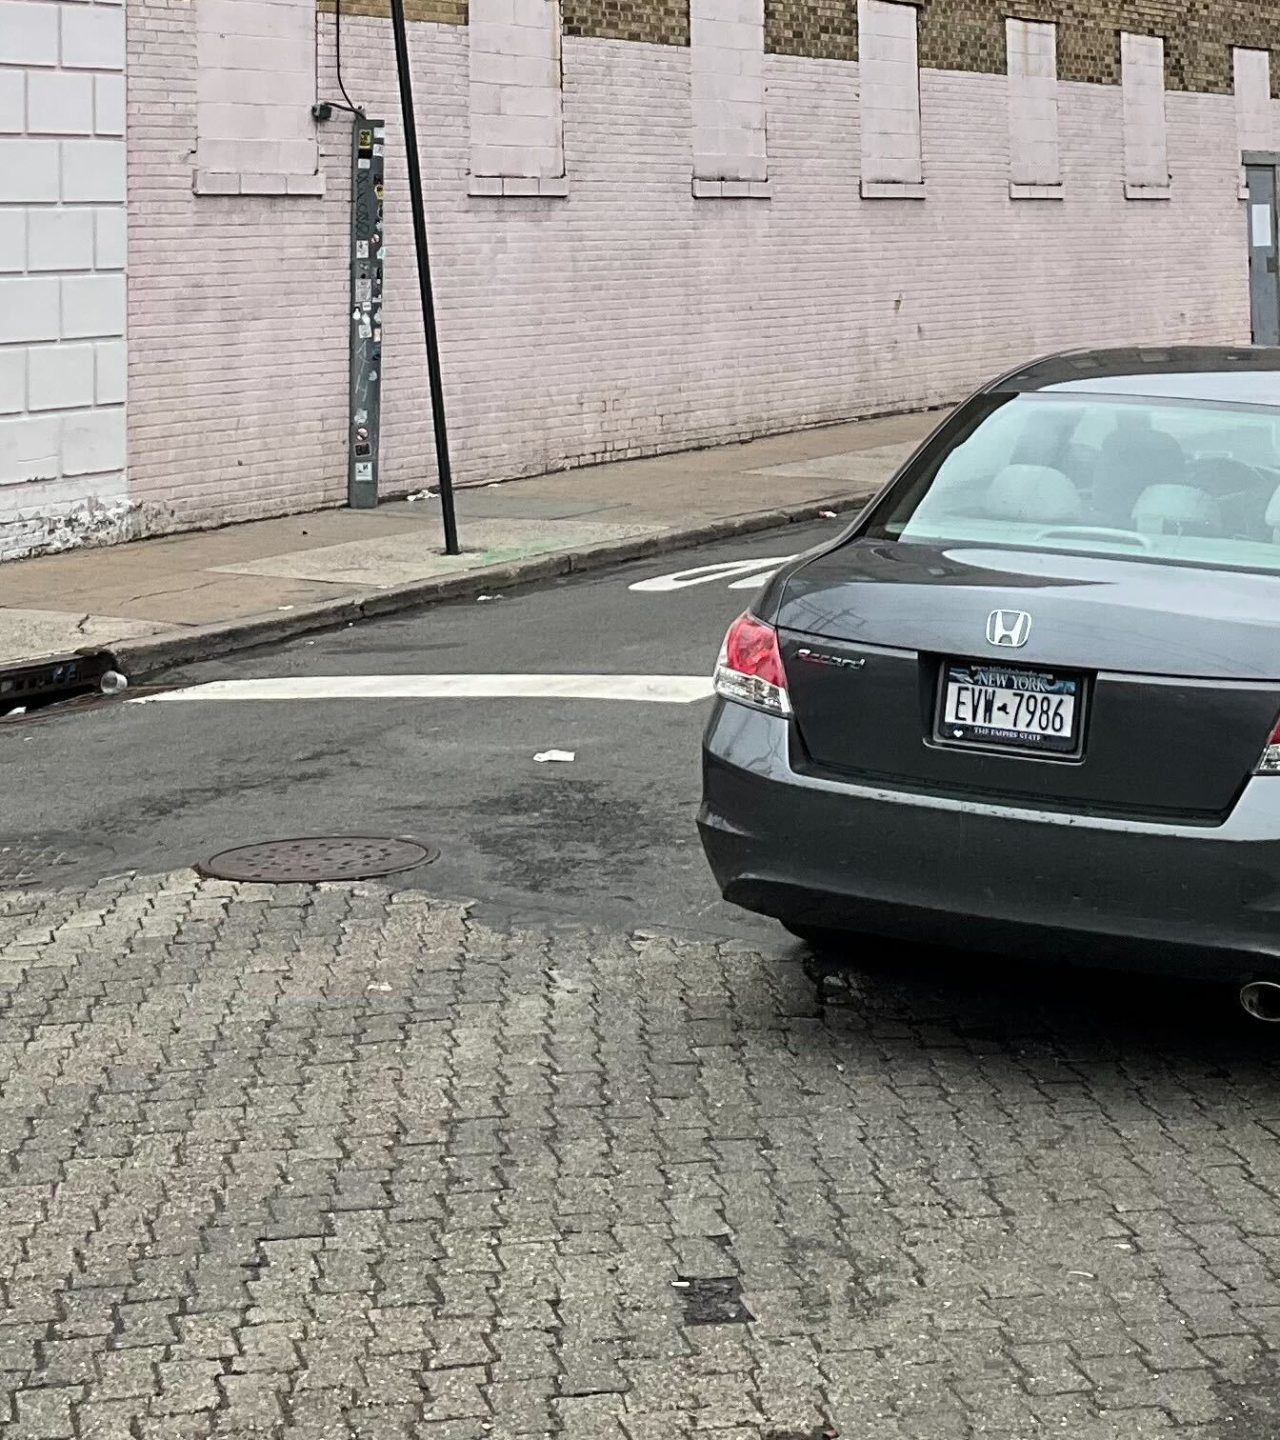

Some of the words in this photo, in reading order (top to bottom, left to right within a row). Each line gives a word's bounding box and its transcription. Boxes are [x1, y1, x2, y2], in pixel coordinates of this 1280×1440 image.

[977, 671, 1008, 689] NEW
[1011, 675, 1048, 693] YORK
[1012, 692, 1064, 733] 7986
